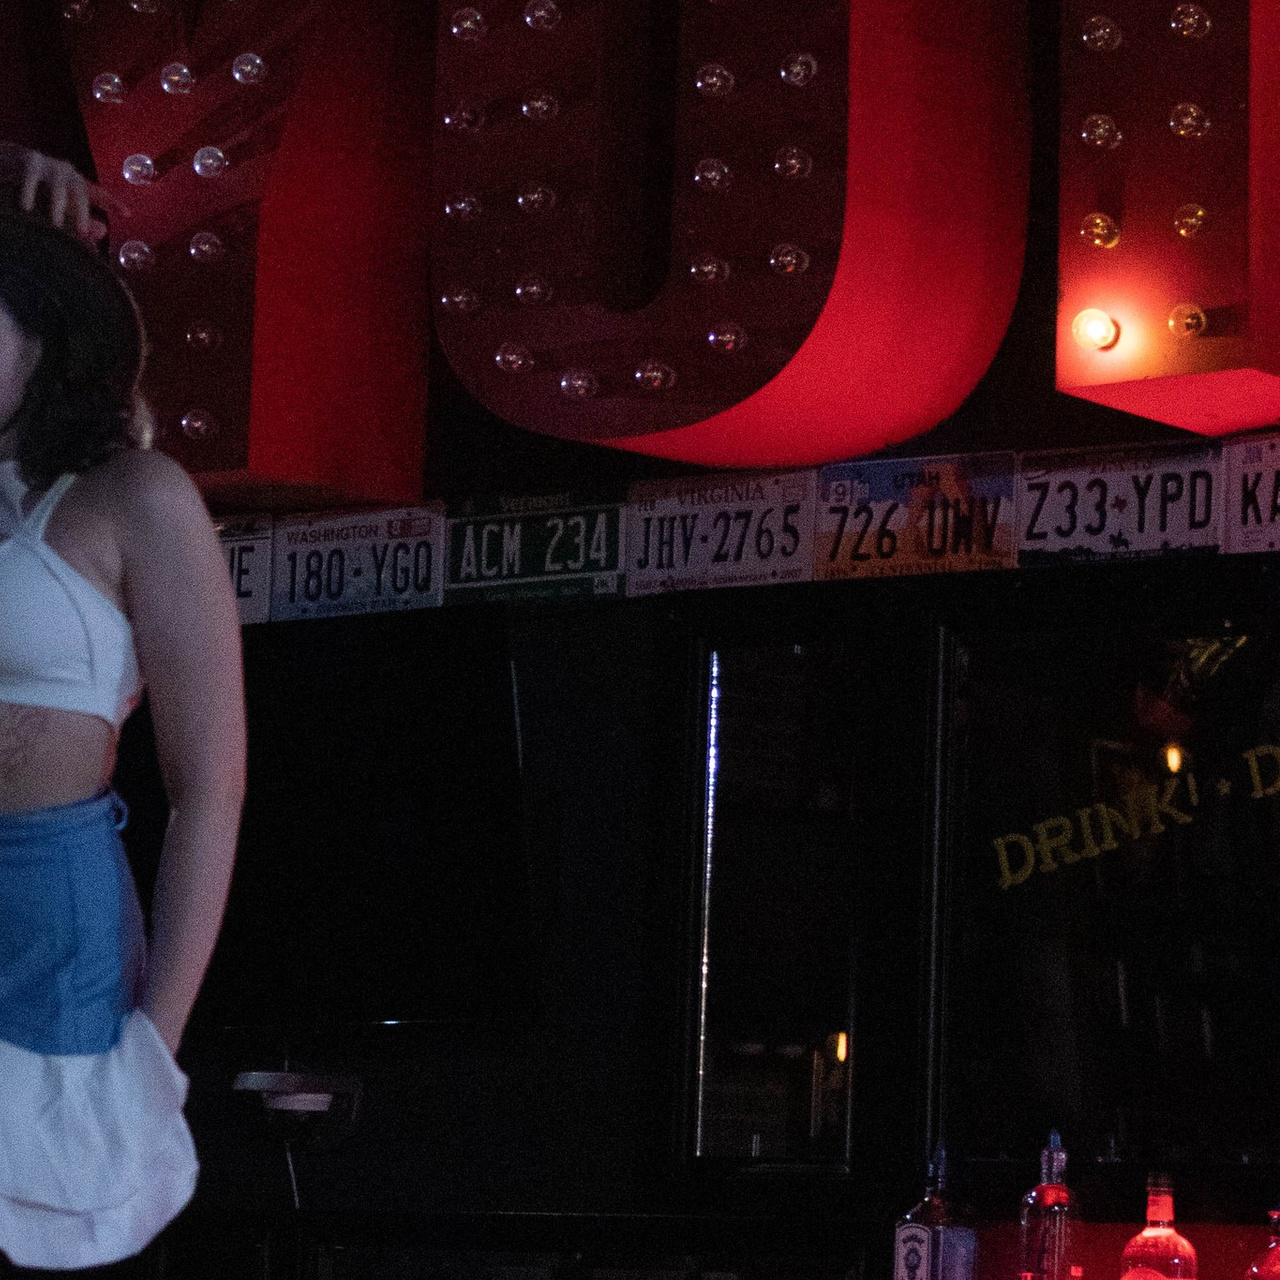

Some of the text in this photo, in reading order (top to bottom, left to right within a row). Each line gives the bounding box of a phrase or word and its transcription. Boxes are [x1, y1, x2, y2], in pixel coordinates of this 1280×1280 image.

[677, 482, 763, 508] VIRGINIA
[287, 524, 379, 546] WASHINGTON
[460, 512, 607, 579] ACM 234
[829, 503, 899, 562] 726
